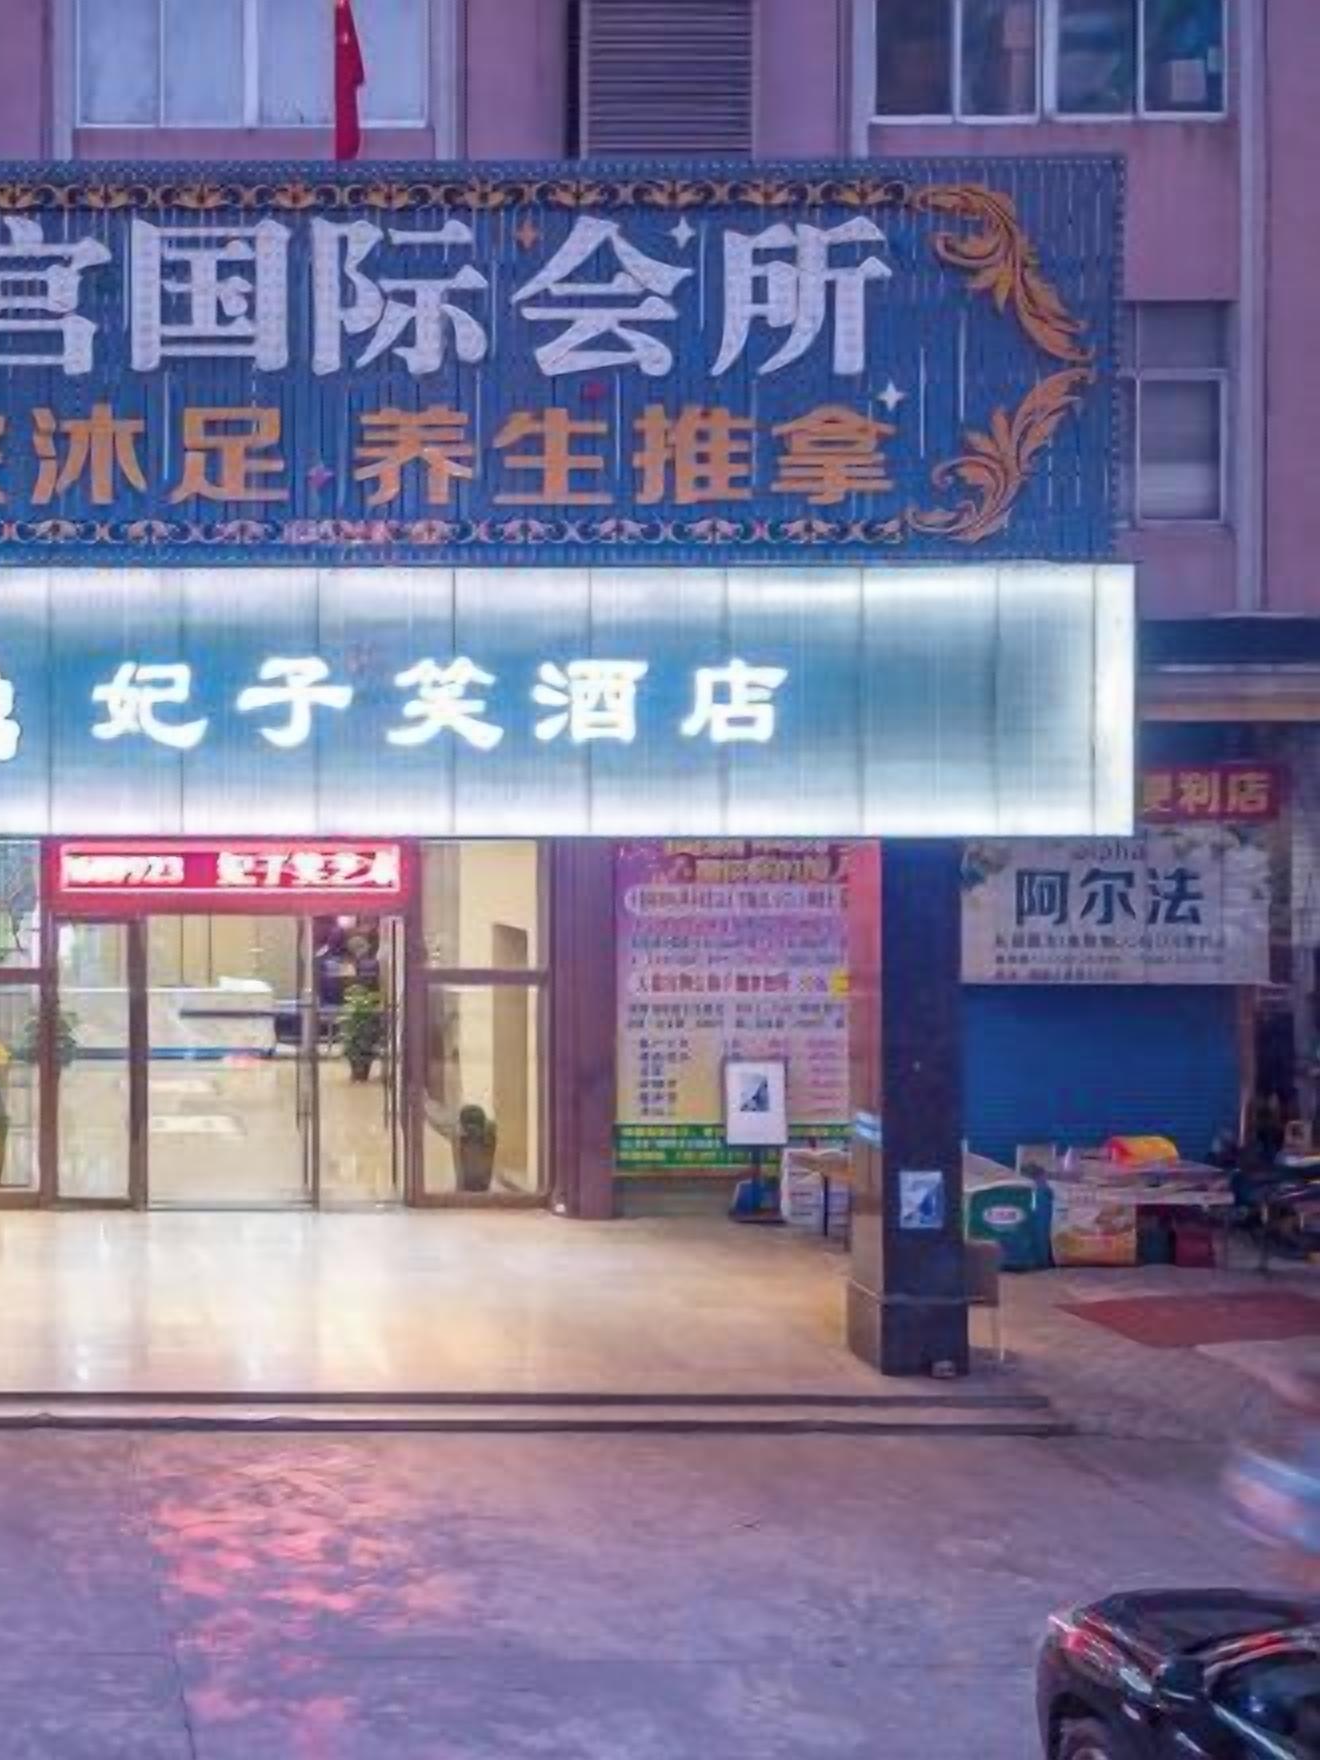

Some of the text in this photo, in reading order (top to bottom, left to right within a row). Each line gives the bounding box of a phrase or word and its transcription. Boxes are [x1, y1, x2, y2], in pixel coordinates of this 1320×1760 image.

[354, 403, 896, 508] 养生推拿
[90, 655, 790, 751] 妃子笑酒店
[1015, 866, 1204, 926] 阿尔法
